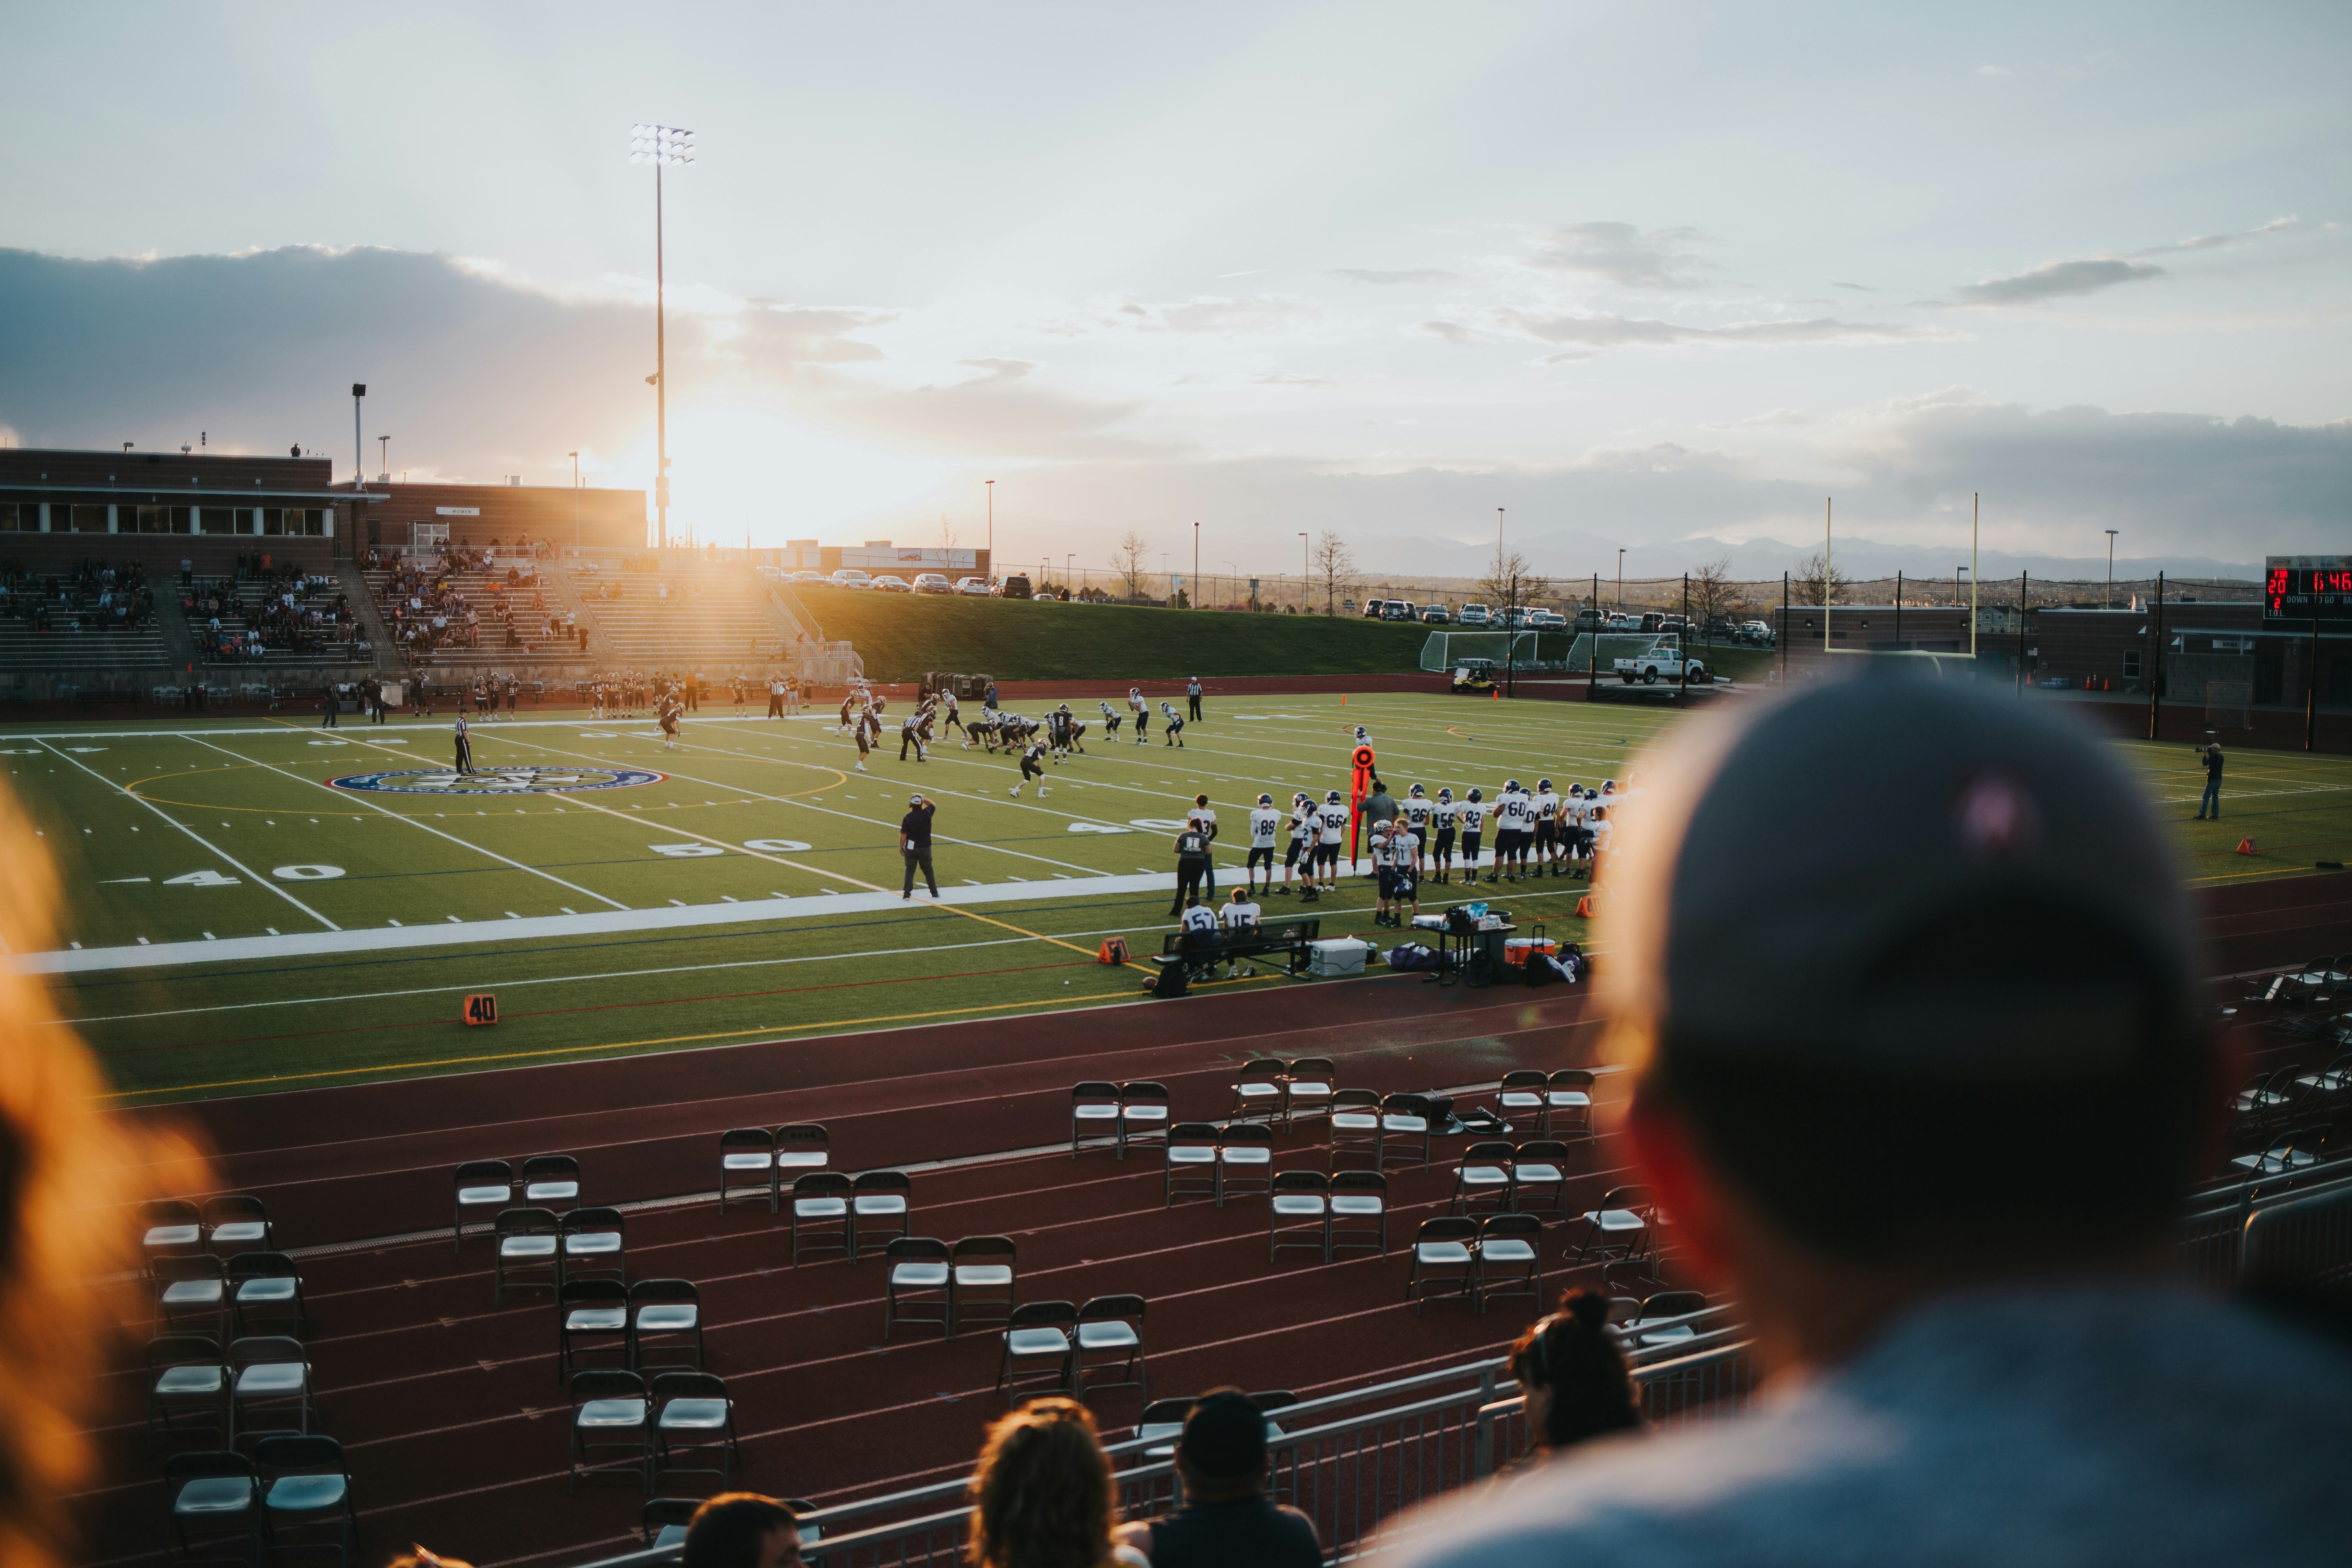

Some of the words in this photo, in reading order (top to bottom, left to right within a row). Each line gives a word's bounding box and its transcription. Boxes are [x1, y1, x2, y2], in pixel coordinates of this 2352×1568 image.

[2268, 579, 2285, 594] 20
[2274, 597, 2281, 609] 2
[1059, 716, 1064, 726] 8
[1411, 808, 1428, 823] 26
[1508, 801, 1526, 817] 60
[1526, 810, 1535, 823] 0
[1327, 814, 1343, 829] 66
[1440, 813, 1455, 828] 56
[1466, 810, 1481, 828] 82
[1203, 820, 1211, 835] 3
[1261, 820, 1276, 836] 89
[648, 839, 813, 857] 50
[1383, 846, 1397, 861] 27
[1397, 847, 1404, 860] 11
[163, 865, 346, 886] 40
[1192, 913, 1215, 929] 57
[1234, 914, 1252, 928] 15
[470, 997, 495, 1022] 40
